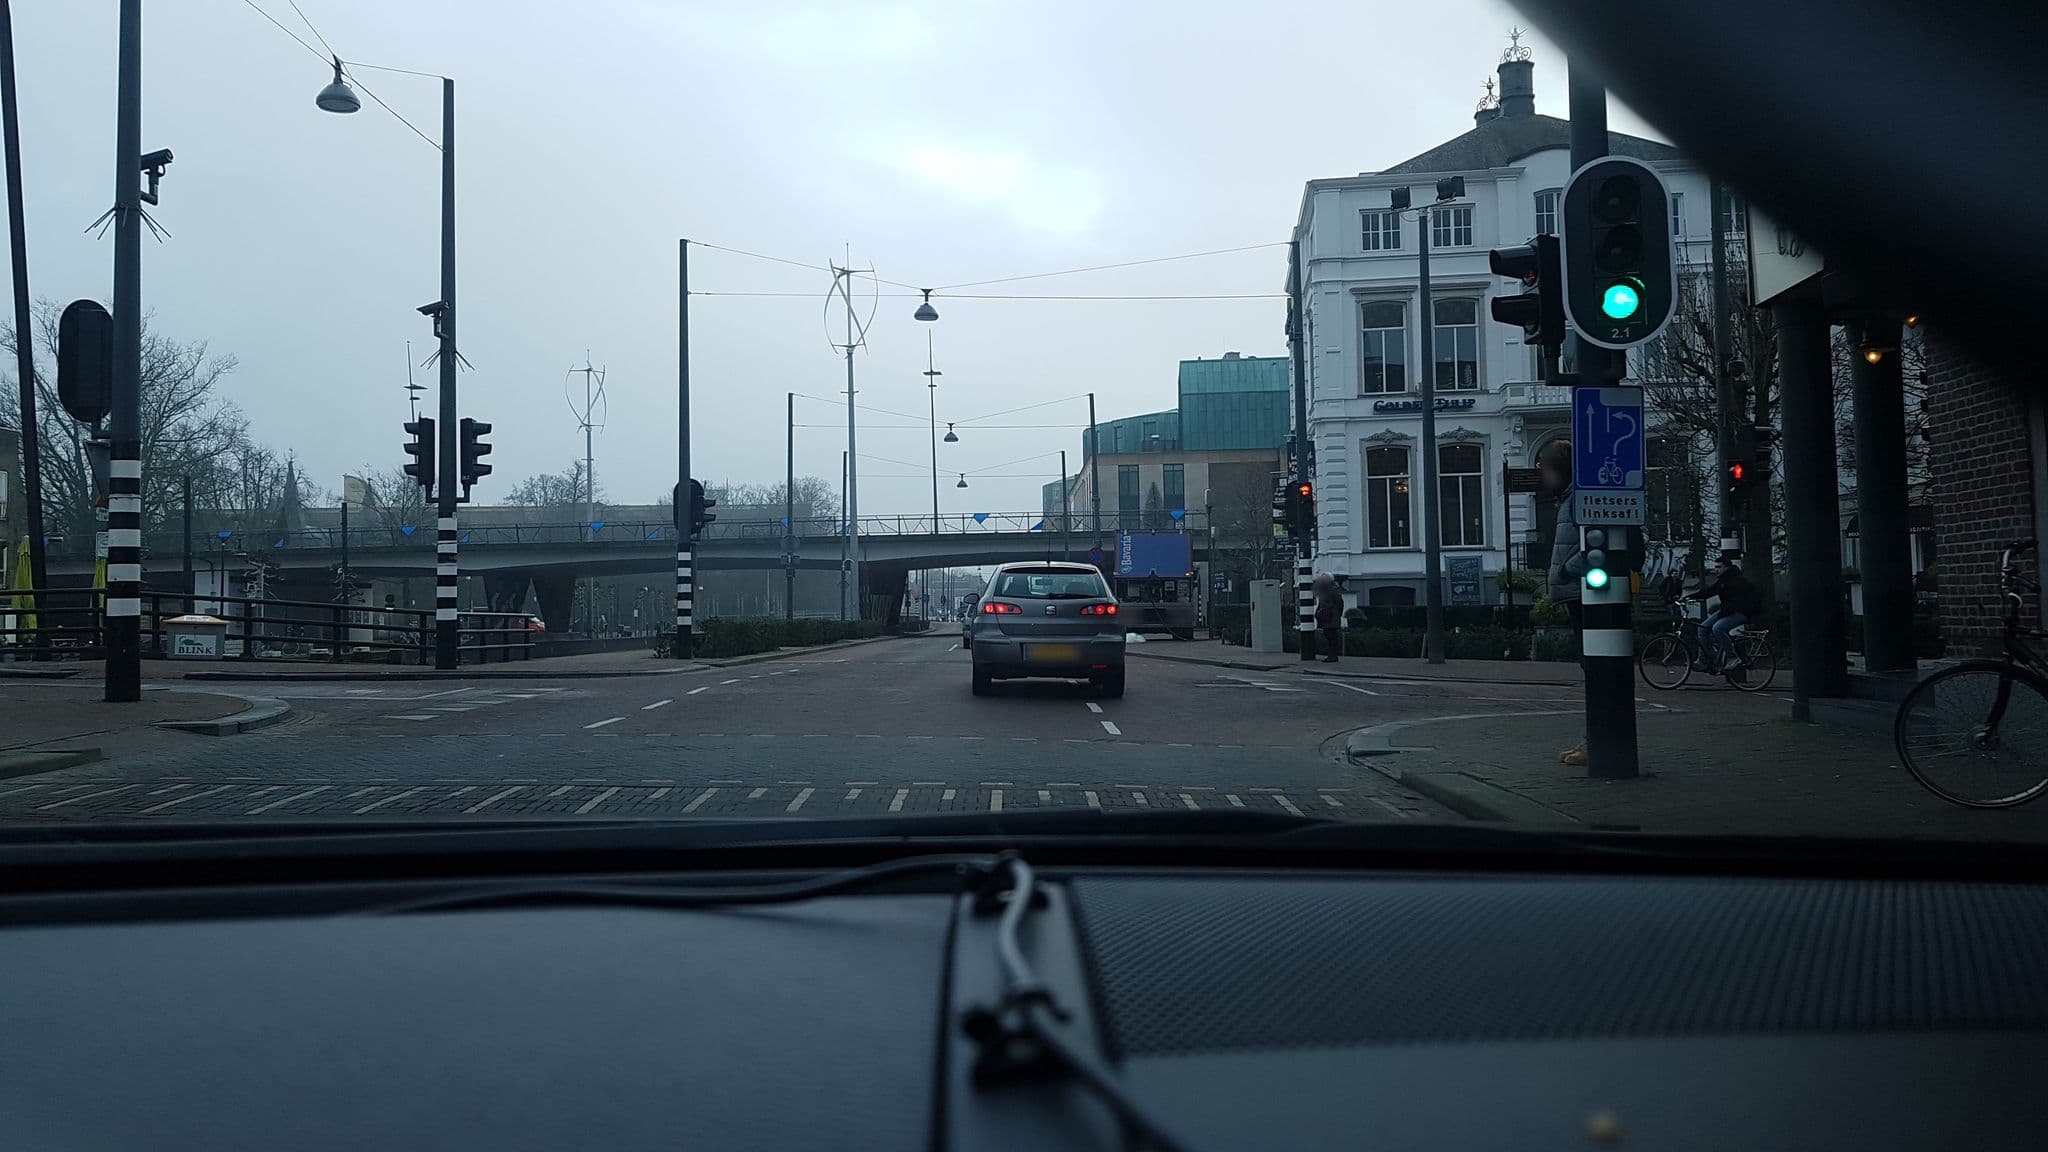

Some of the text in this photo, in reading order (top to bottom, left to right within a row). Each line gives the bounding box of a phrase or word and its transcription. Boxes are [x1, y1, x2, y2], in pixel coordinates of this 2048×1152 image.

[1611, 327, 1631, 339] 2.1
[1583, 495, 1637, 506] fietsers
[1583, 508, 1638, 519] linksaf!
[1120, 535, 1131, 565] Bavaria
[178, 646, 212, 654] BLINK
